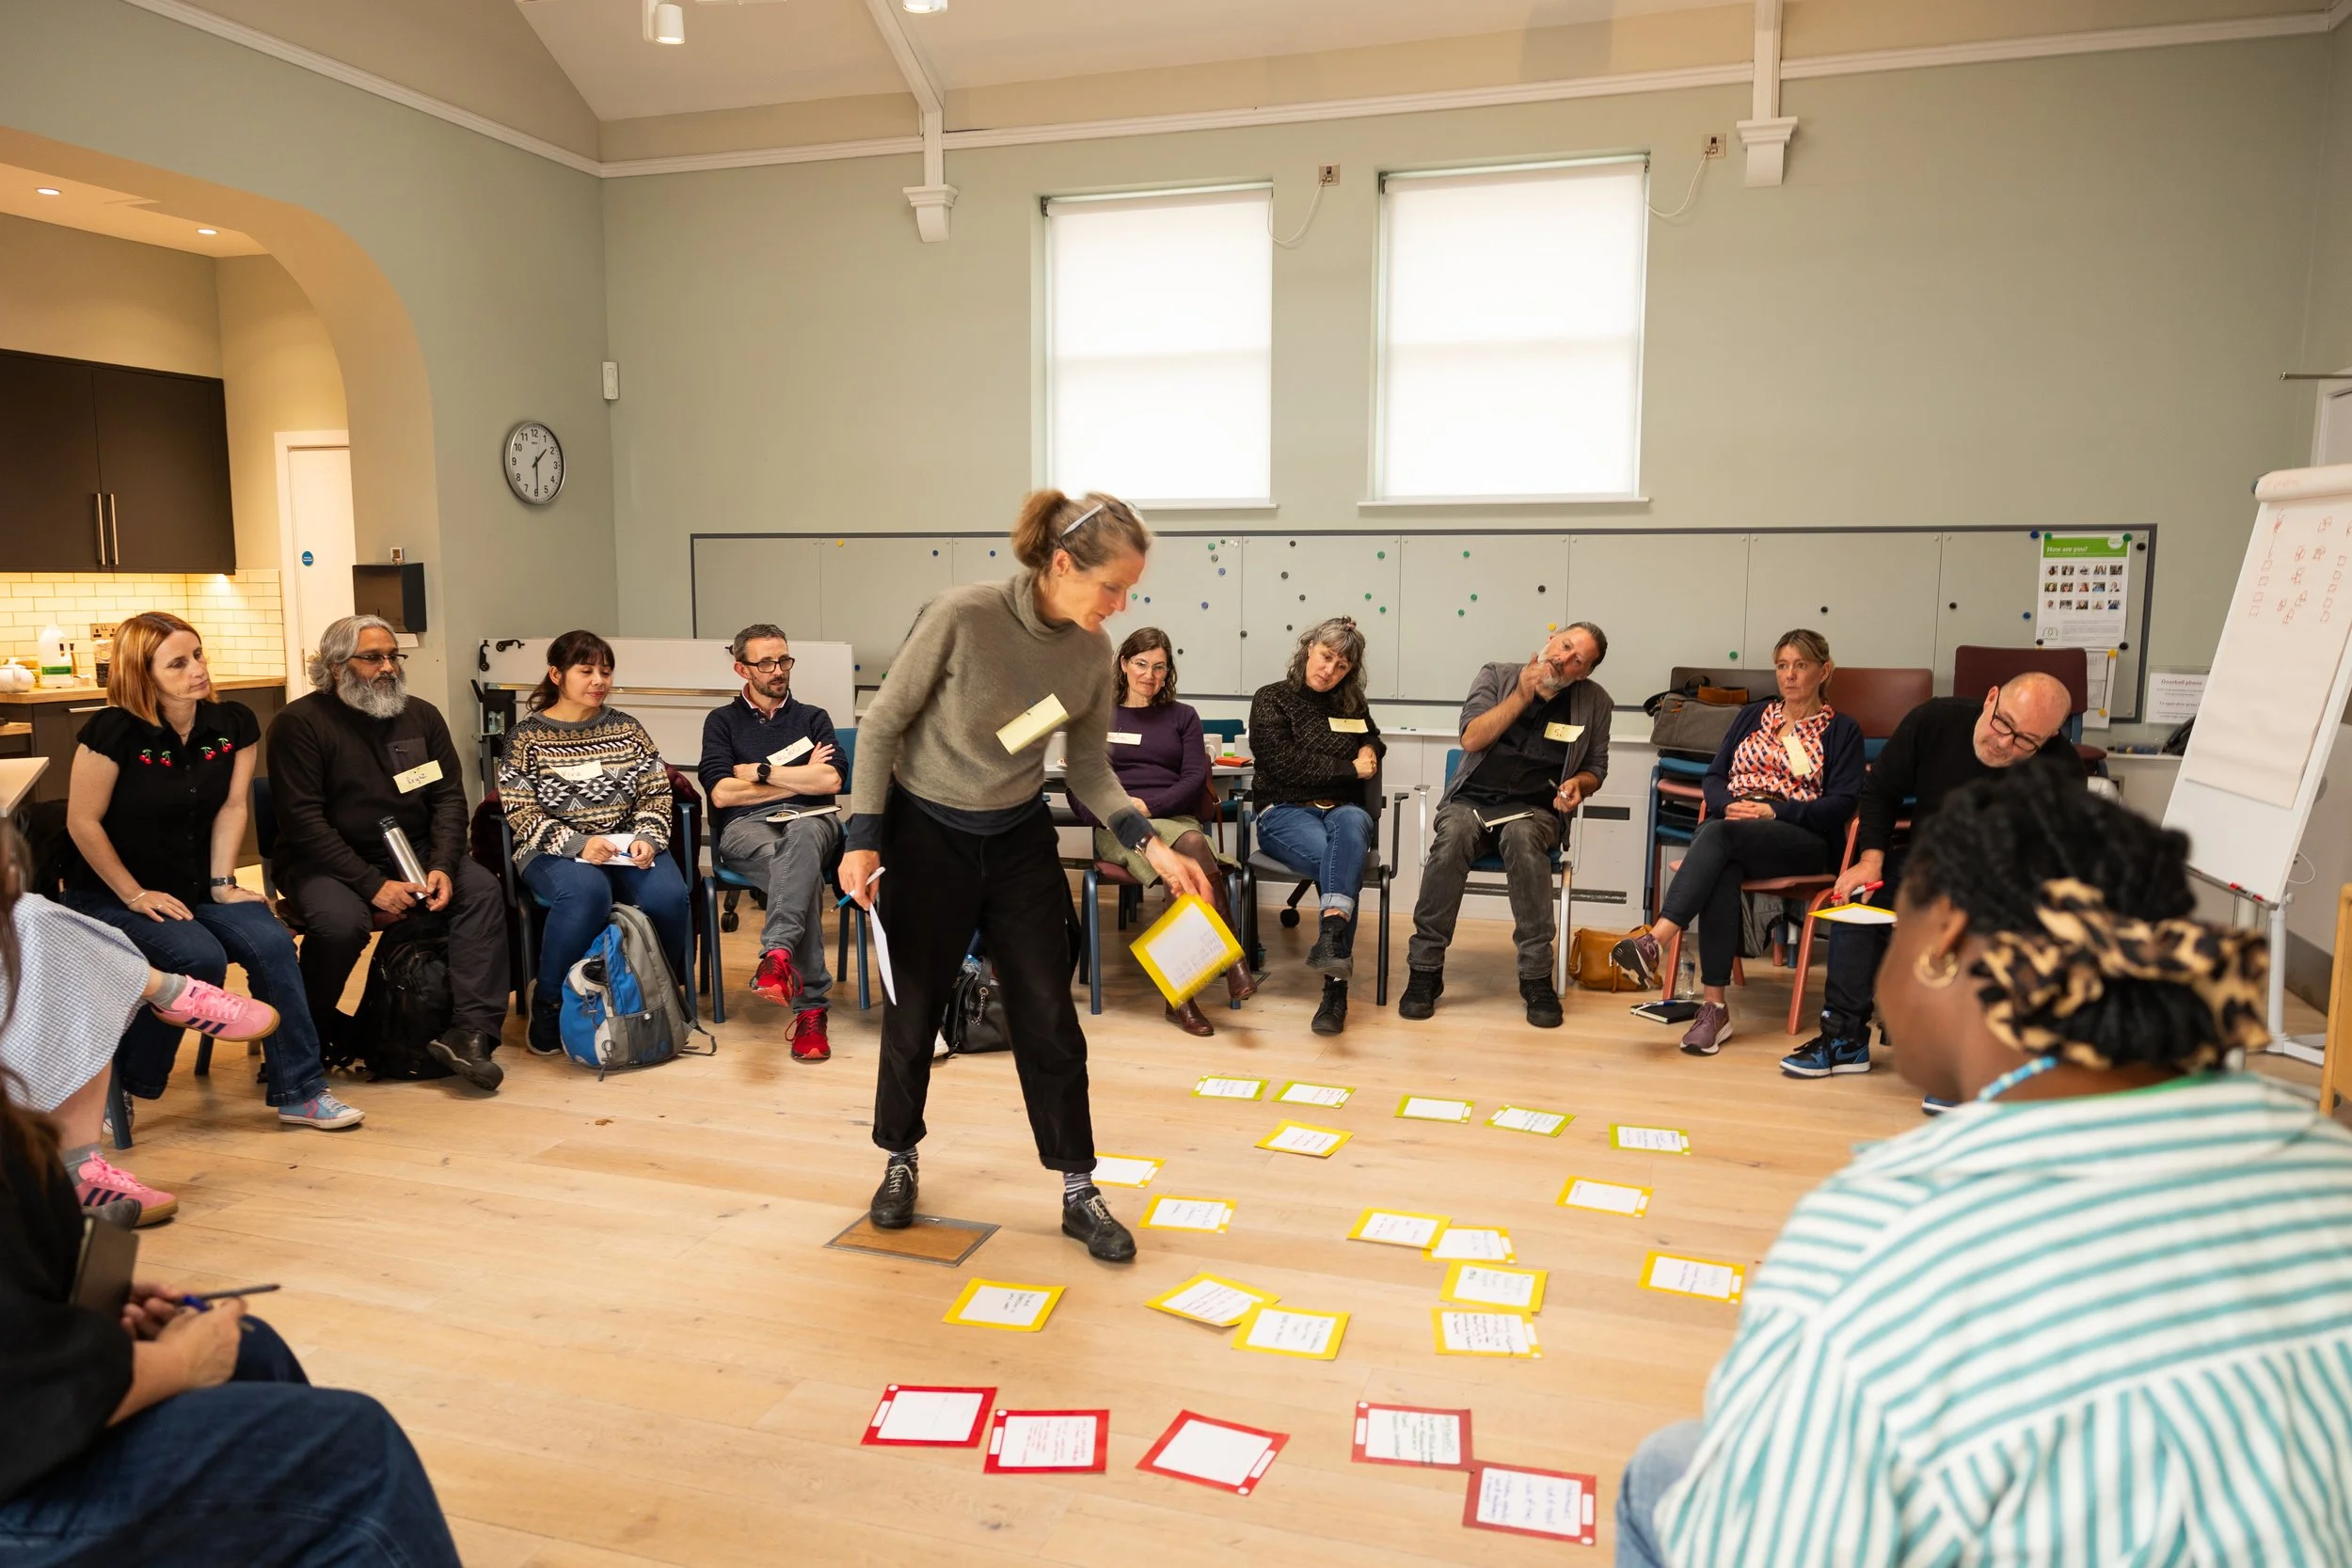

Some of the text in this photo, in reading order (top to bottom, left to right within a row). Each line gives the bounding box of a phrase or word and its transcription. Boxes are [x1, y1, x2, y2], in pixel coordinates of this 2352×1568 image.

[520, 433, 528, 441] 11
[531, 429, 538, 437] 12
[543, 435, 547, 443] 1
[514, 443, 522, 451] 10
[549, 446, 555, 454] 2
[512, 457, 516, 466] 9
[553, 461, 558, 469] 3
[516, 473, 521, 482] 8
[550, 475, 555, 483] 4
[524, 483, 529, 492] 7
[544, 485, 548, 494] 5
[2073, 546, 2089, 555] you?
